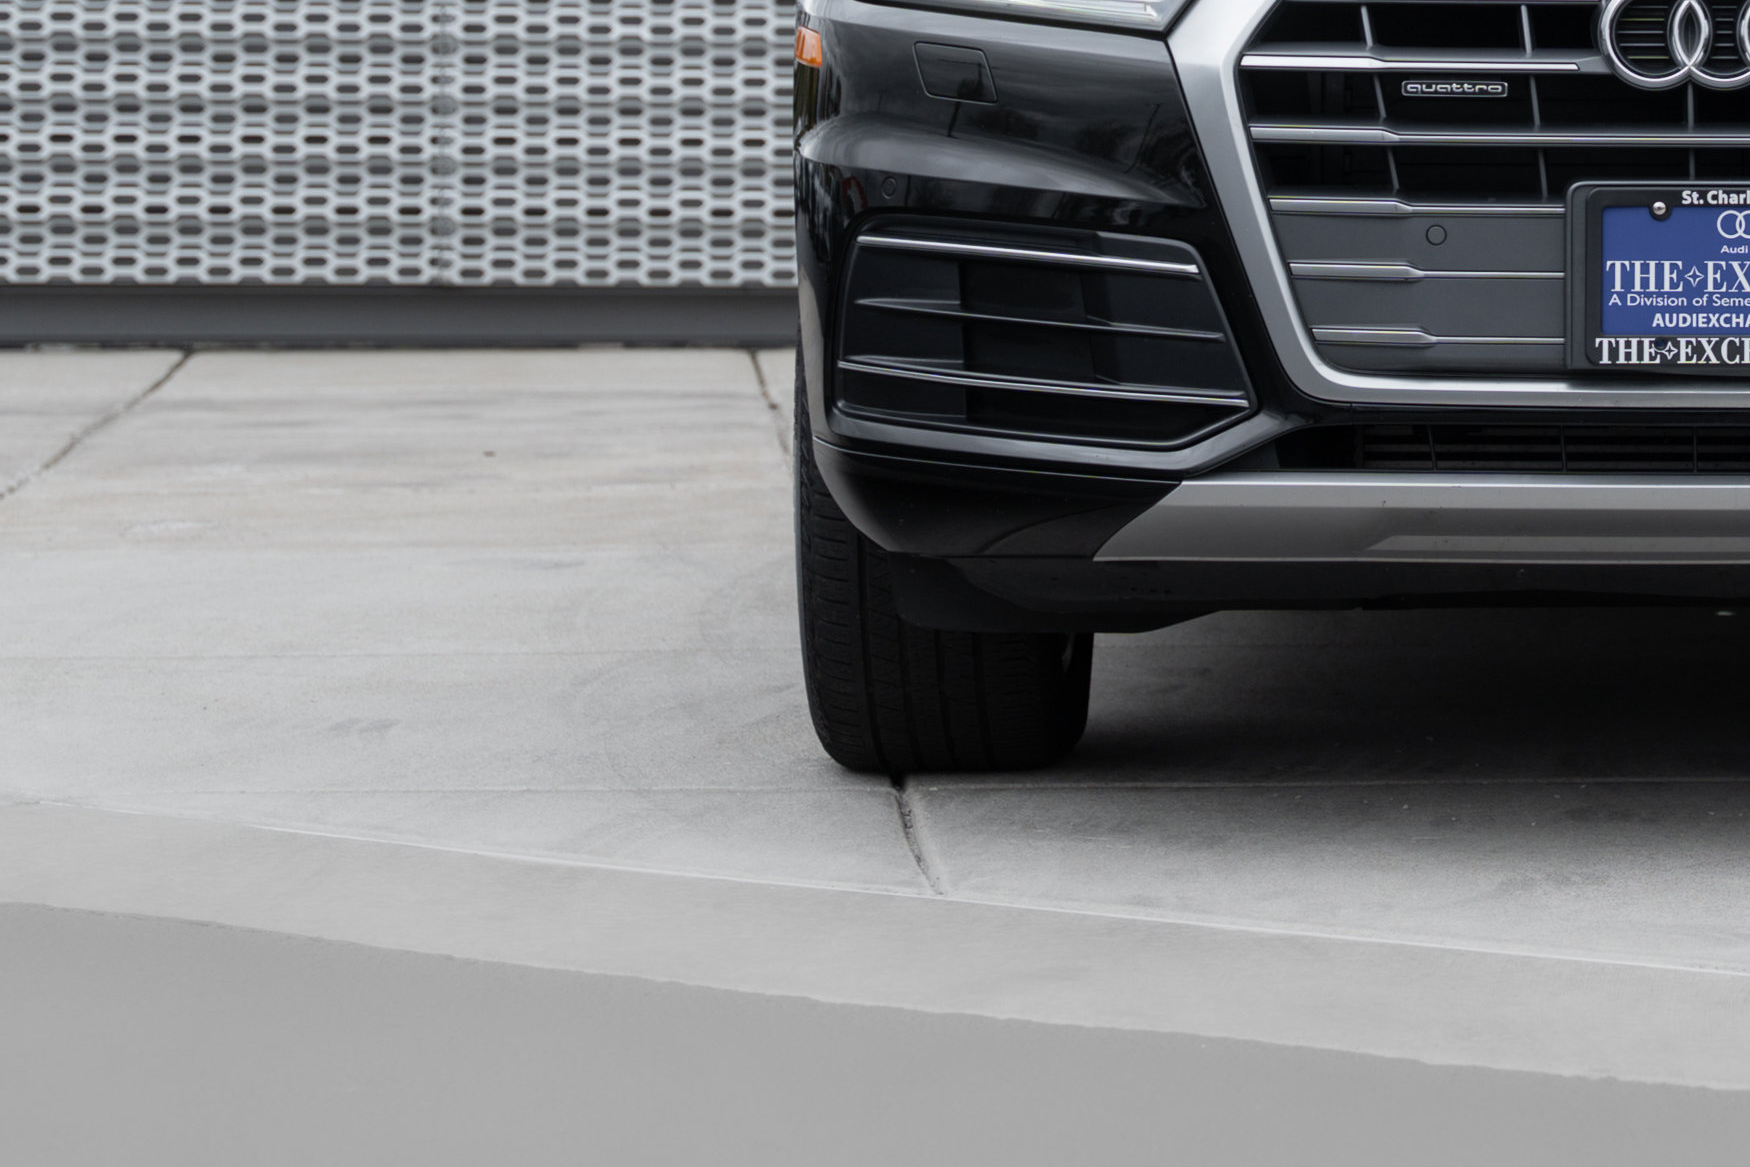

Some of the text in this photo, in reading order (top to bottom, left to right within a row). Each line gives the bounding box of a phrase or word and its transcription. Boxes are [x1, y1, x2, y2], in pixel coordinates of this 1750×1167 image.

[1406, 83, 1503, 94] quattro
[1681, 190, 1704, 205] St.
[1720, 245, 1749, 254] Audi
[1606, 260, 1683, 292] THE
[1608, 294, 1622, 306] A
[1627, 294, 1687, 306] Division
[1692, 294, 1709, 306] of
